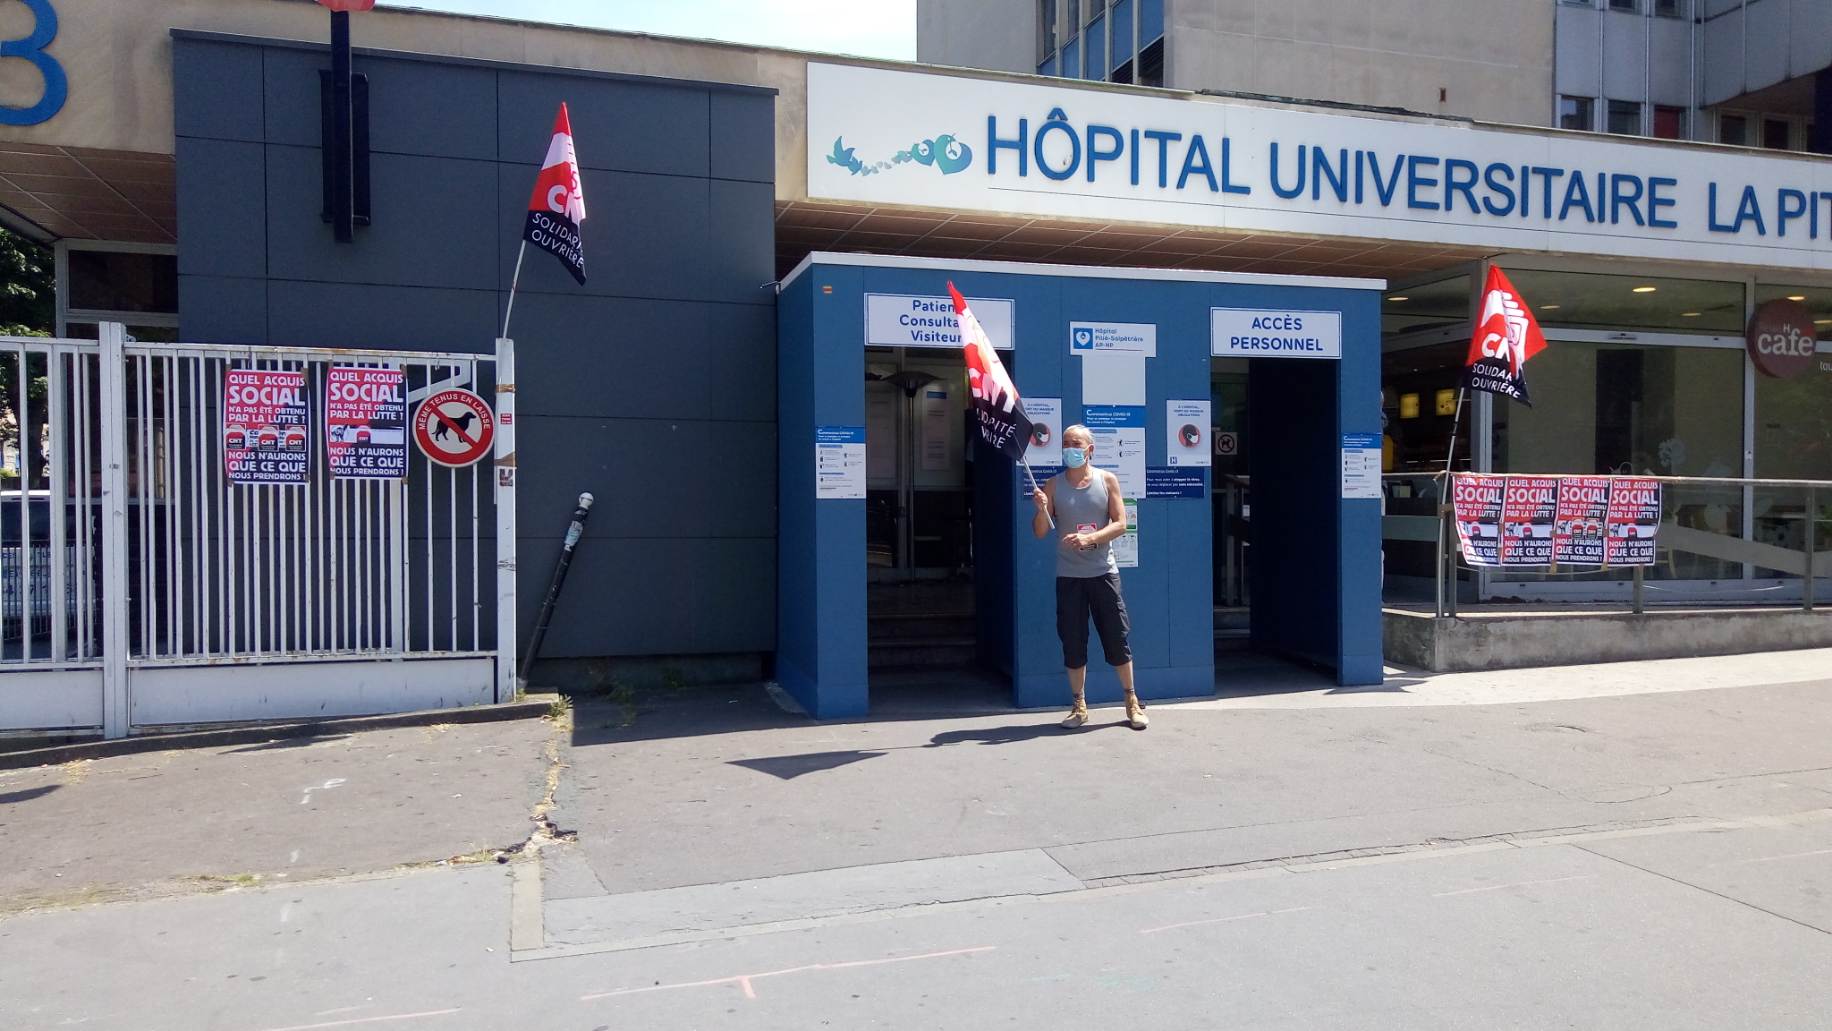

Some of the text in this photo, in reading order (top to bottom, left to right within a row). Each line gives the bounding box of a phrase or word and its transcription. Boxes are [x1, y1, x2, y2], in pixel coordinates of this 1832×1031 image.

[988, 107, 1251, 195] HÔPITAL
[1270, 142, 1678, 228] UNIVERSITAIRE
[1709, 182, 1766, 236] LA
[912, 300, 956, 312] Patien
[900, 314, 960, 328] Consulta
[1252, 314, 1303, 331] ACCÈS
[911, 330, 962, 343] Visiteur
[1230, 336, 1324, 351] PERSONNEL
[229, 375, 305, 386] QUEL ACQUIS
[330, 372, 403, 383] QUEL ACQUIS
[229, 386, 305, 405] SOCIAL
[330, 383, 403, 402] SOCIAL
[330, 410, 349, 418] PAR
[353, 411, 364, 419] LA
[430, 393, 458, 406] TENUS
[460, 394, 473, 404] EN
[473, 401, 491, 430] LAISSE
[229, 414, 248, 422] PAR
[268, 415, 298, 423] LUTTE
[259, 452, 305, 460] N'AURONS
[359, 448, 403, 456] N'AURONS
[229, 461, 305, 472] QUE CE QUE
[330, 456, 403, 467] QUE CE QUE
[1480, 479, 1503, 487] ACQUIS
[1563, 478, 1608, 487] QUEL ACQUIS
[1634, 481, 1657, 489] ACQUIS
[1456, 486, 1501, 503] SOCIAL
[1508, 489, 1555, 503] SOCIAL
[1561, 487, 1607, 503] SOCIAL
[1612, 490, 1658, 504] SOCIAL
[1484, 548, 1497, 556] QUE
[1505, 548, 1551, 556] QUE CE QUE
[1556, 546, 1602, 555] QUE CE QUE
[1609, 548, 1653, 556] QUE CE QUE
